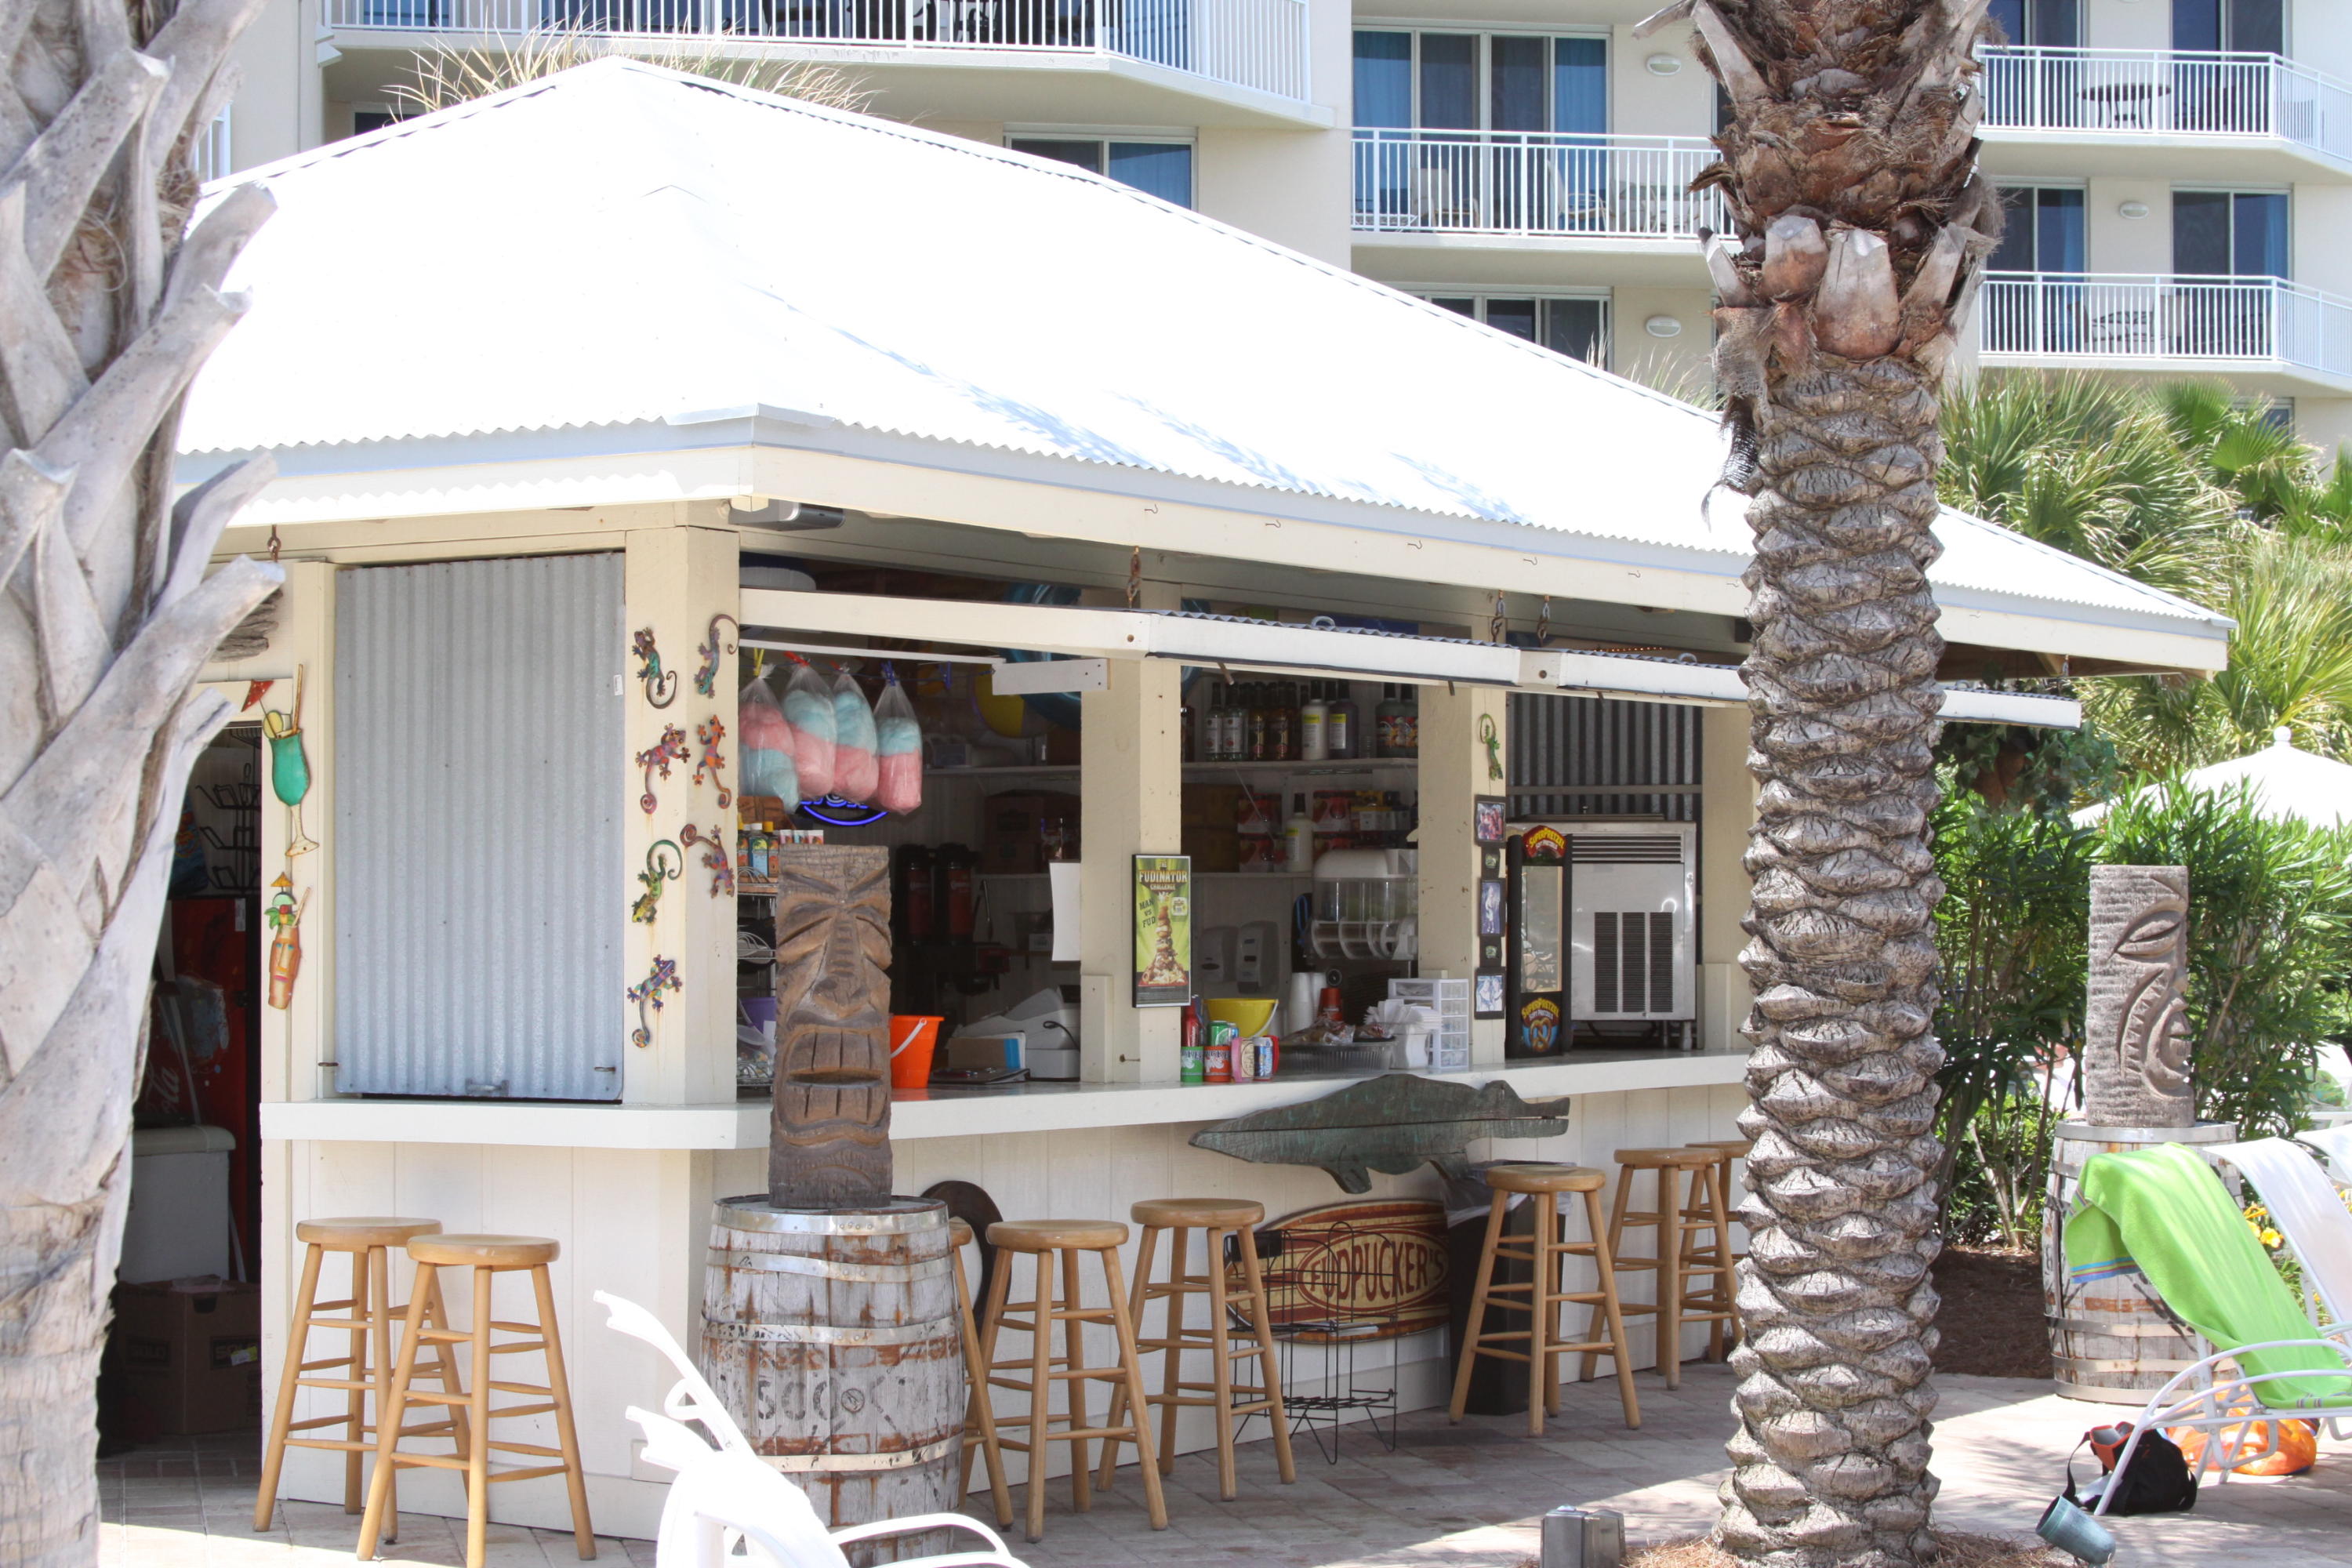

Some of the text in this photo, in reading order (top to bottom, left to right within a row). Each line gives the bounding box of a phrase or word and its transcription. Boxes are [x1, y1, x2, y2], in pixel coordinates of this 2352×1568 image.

[1139, 869, 1188, 883] FUDINATOR
[1139, 898, 1155, 910] MAN
[1142, 916, 1156, 928] FUD
[1310, 1240, 1444, 1301] FUDPUCKER'S
